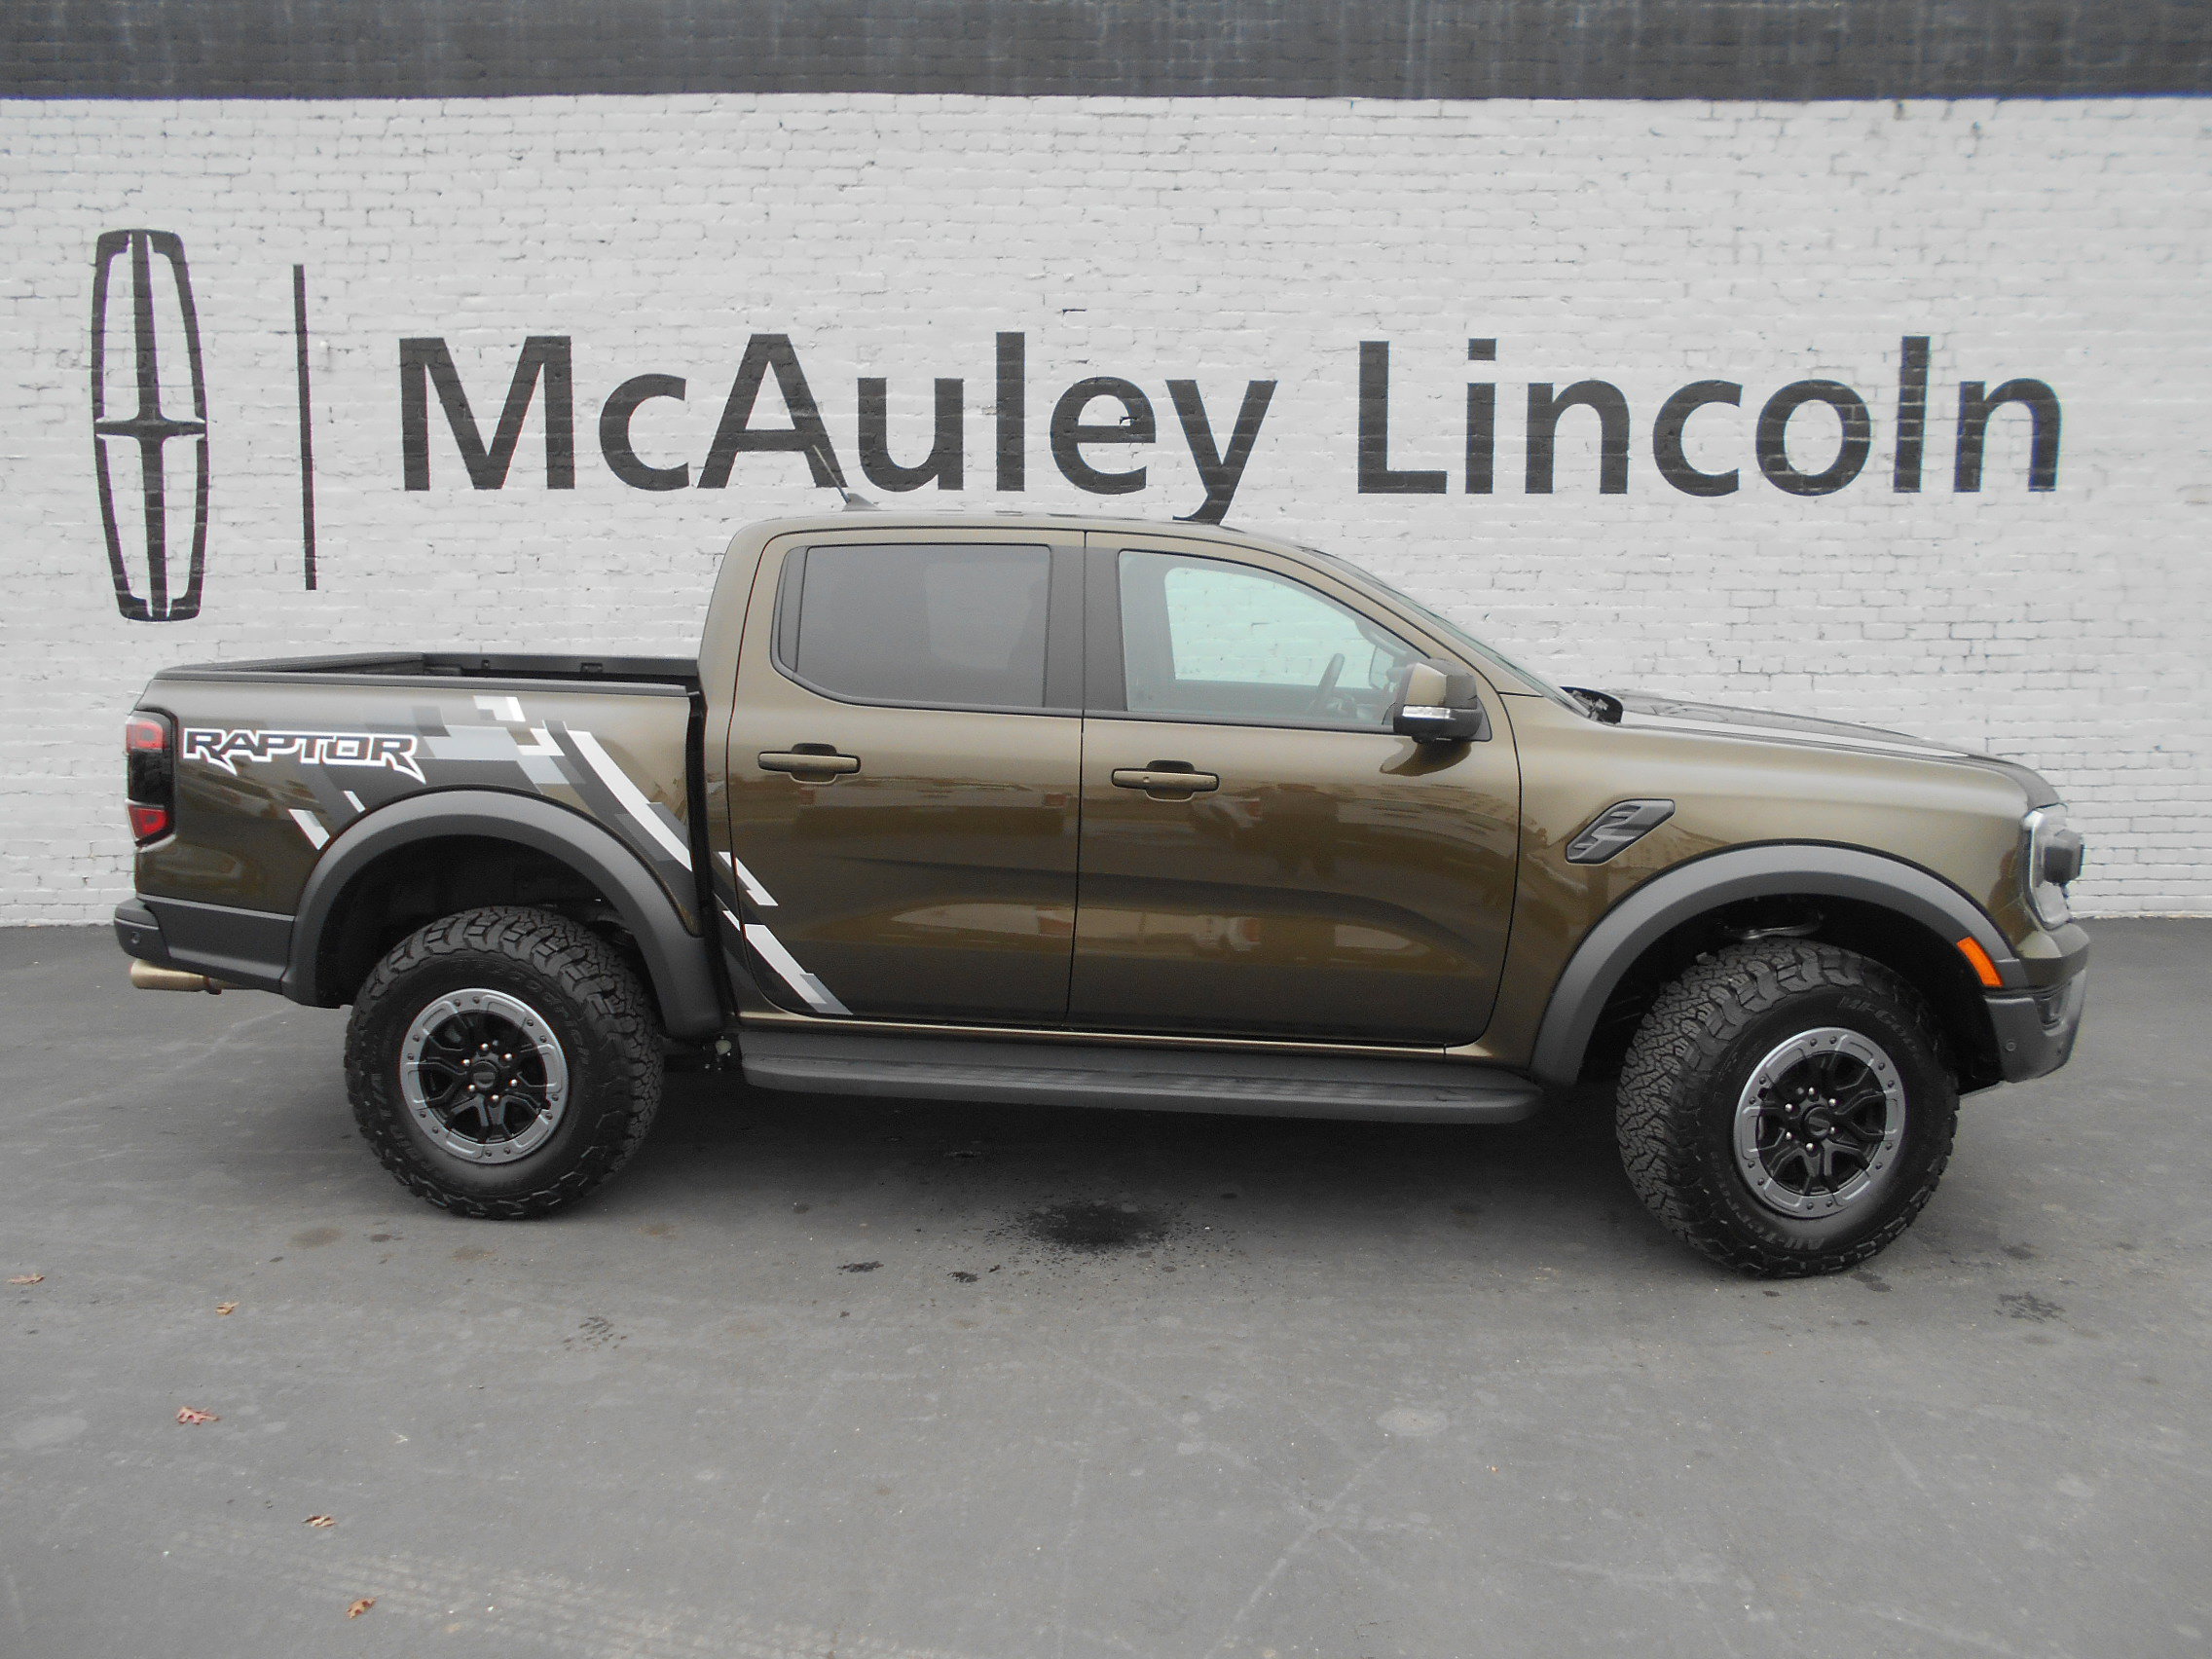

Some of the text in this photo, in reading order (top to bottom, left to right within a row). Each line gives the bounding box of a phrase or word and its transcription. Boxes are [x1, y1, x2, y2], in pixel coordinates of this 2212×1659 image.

[398, 331, 2062, 524] McAuley Lincoln
[182, 727, 426, 784] RAPTOR
